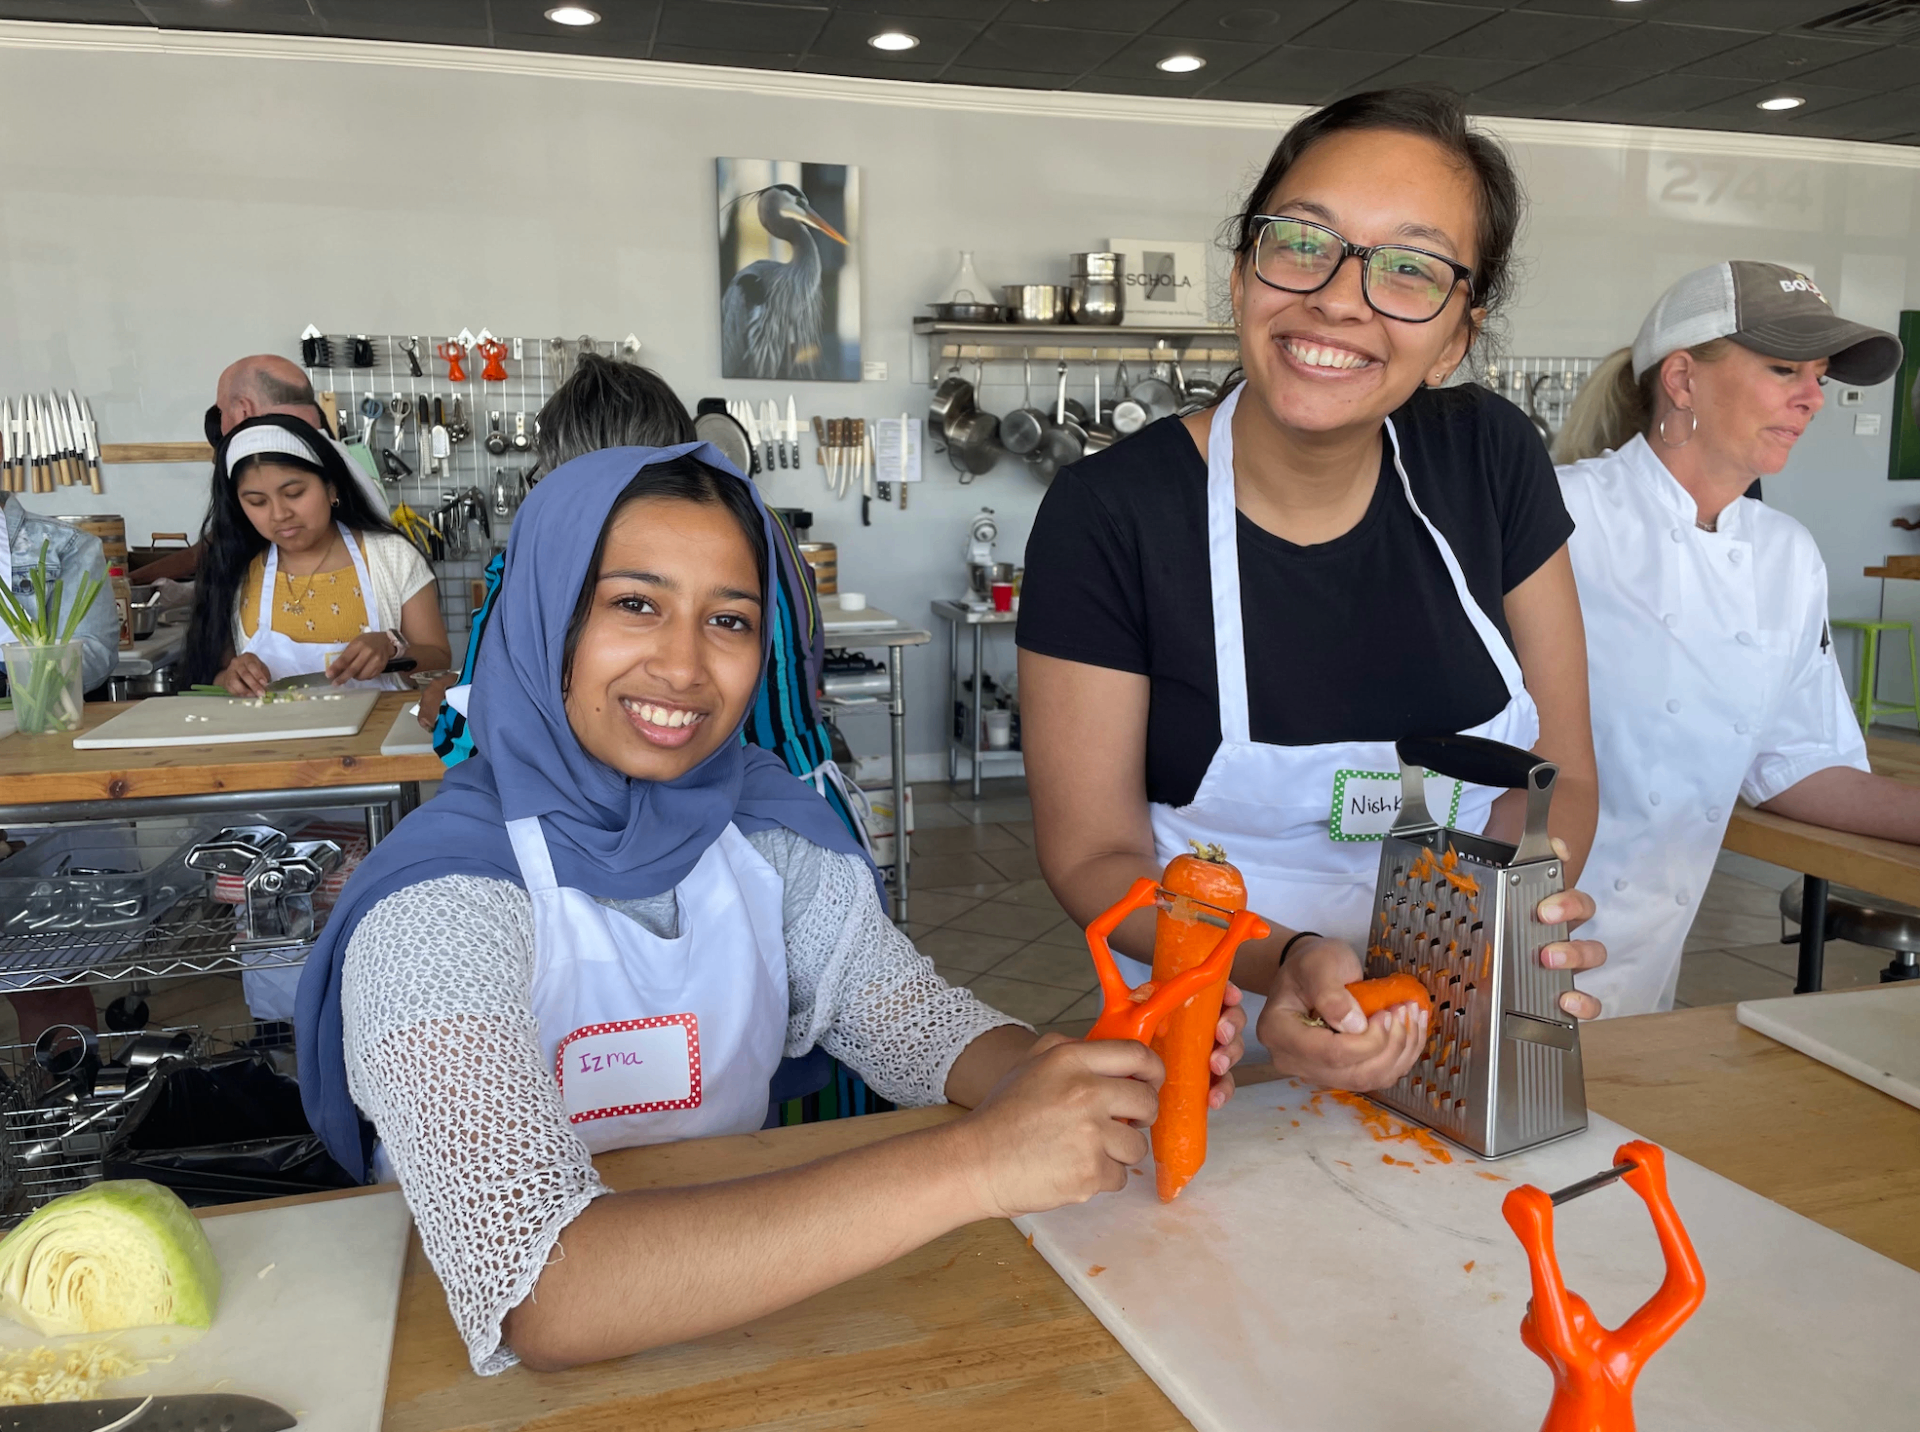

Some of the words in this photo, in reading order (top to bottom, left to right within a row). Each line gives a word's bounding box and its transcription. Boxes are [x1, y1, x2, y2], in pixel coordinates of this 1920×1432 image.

[1660, 158, 1815, 214] 2744
[1126, 274, 1191, 288] SCHOLA
[579, 1052, 643, 1073] Izma
